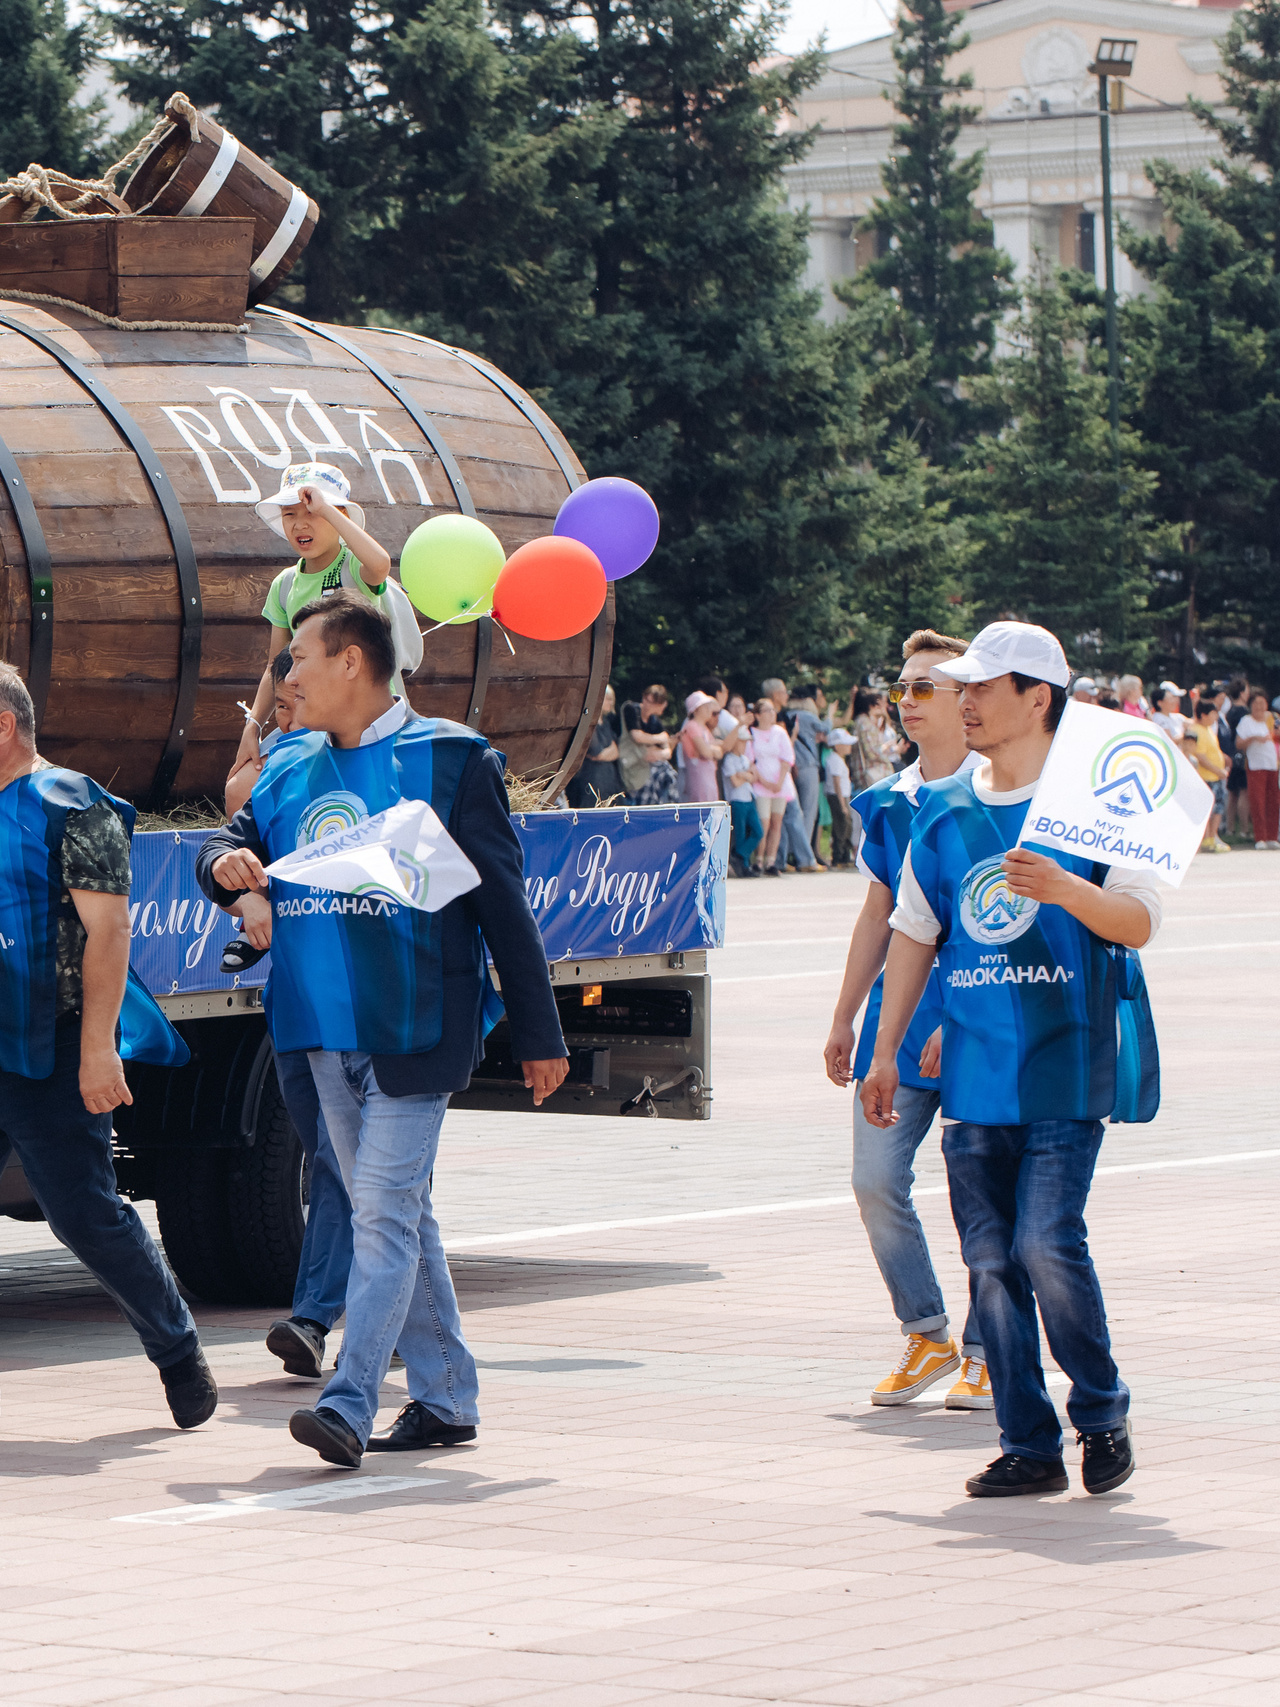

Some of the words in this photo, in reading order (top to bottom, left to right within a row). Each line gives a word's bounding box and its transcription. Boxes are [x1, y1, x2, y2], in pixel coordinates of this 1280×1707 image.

[159, 385, 434, 506] ВОДА
[1029, 816, 1180, 871] «ВОДОКАНАЛ»
[1093, 819, 1125, 836] МУП
[569, 834, 677, 936] Воду!
[979, 953, 1008, 965] МУП
